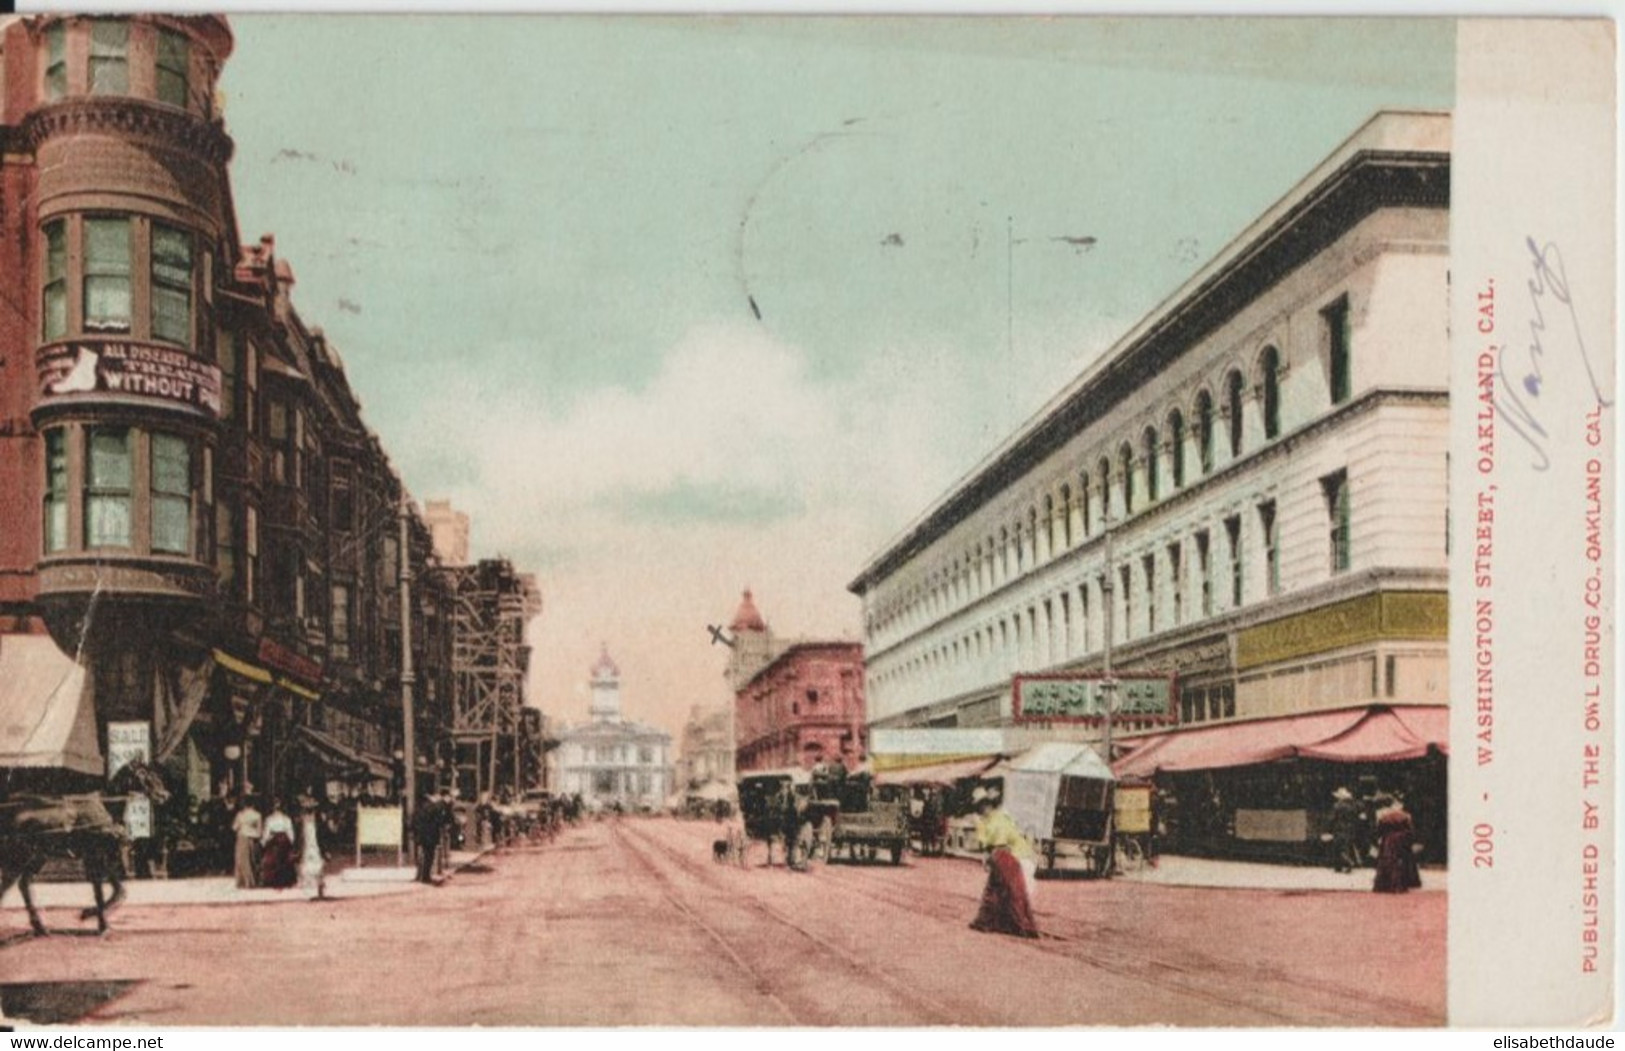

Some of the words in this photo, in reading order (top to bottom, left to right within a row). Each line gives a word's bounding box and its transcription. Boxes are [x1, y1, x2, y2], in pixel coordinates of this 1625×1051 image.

[1477, 277, 1495, 334] CAL.
[103, 343, 126, 359] ALL
[103, 370, 193, 400] WITHOUT
[1477, 344, 1498, 475] OAKLAND,
[1476, 484, 1497, 588] STREET,
[1585, 458, 1602, 562] OAKLAND
[1585, 616, 1601, 677] DRUG
[1475, 600, 1494, 766] WASHINGTON
[1585, 683, 1601, 731] OWL
[1583, 743, 1600, 789] THE
[1583, 800, 1599, 830] BY
[1474, 823, 1494, 868] 200
[1582, 844, 1599, 973] PUBLISHED
